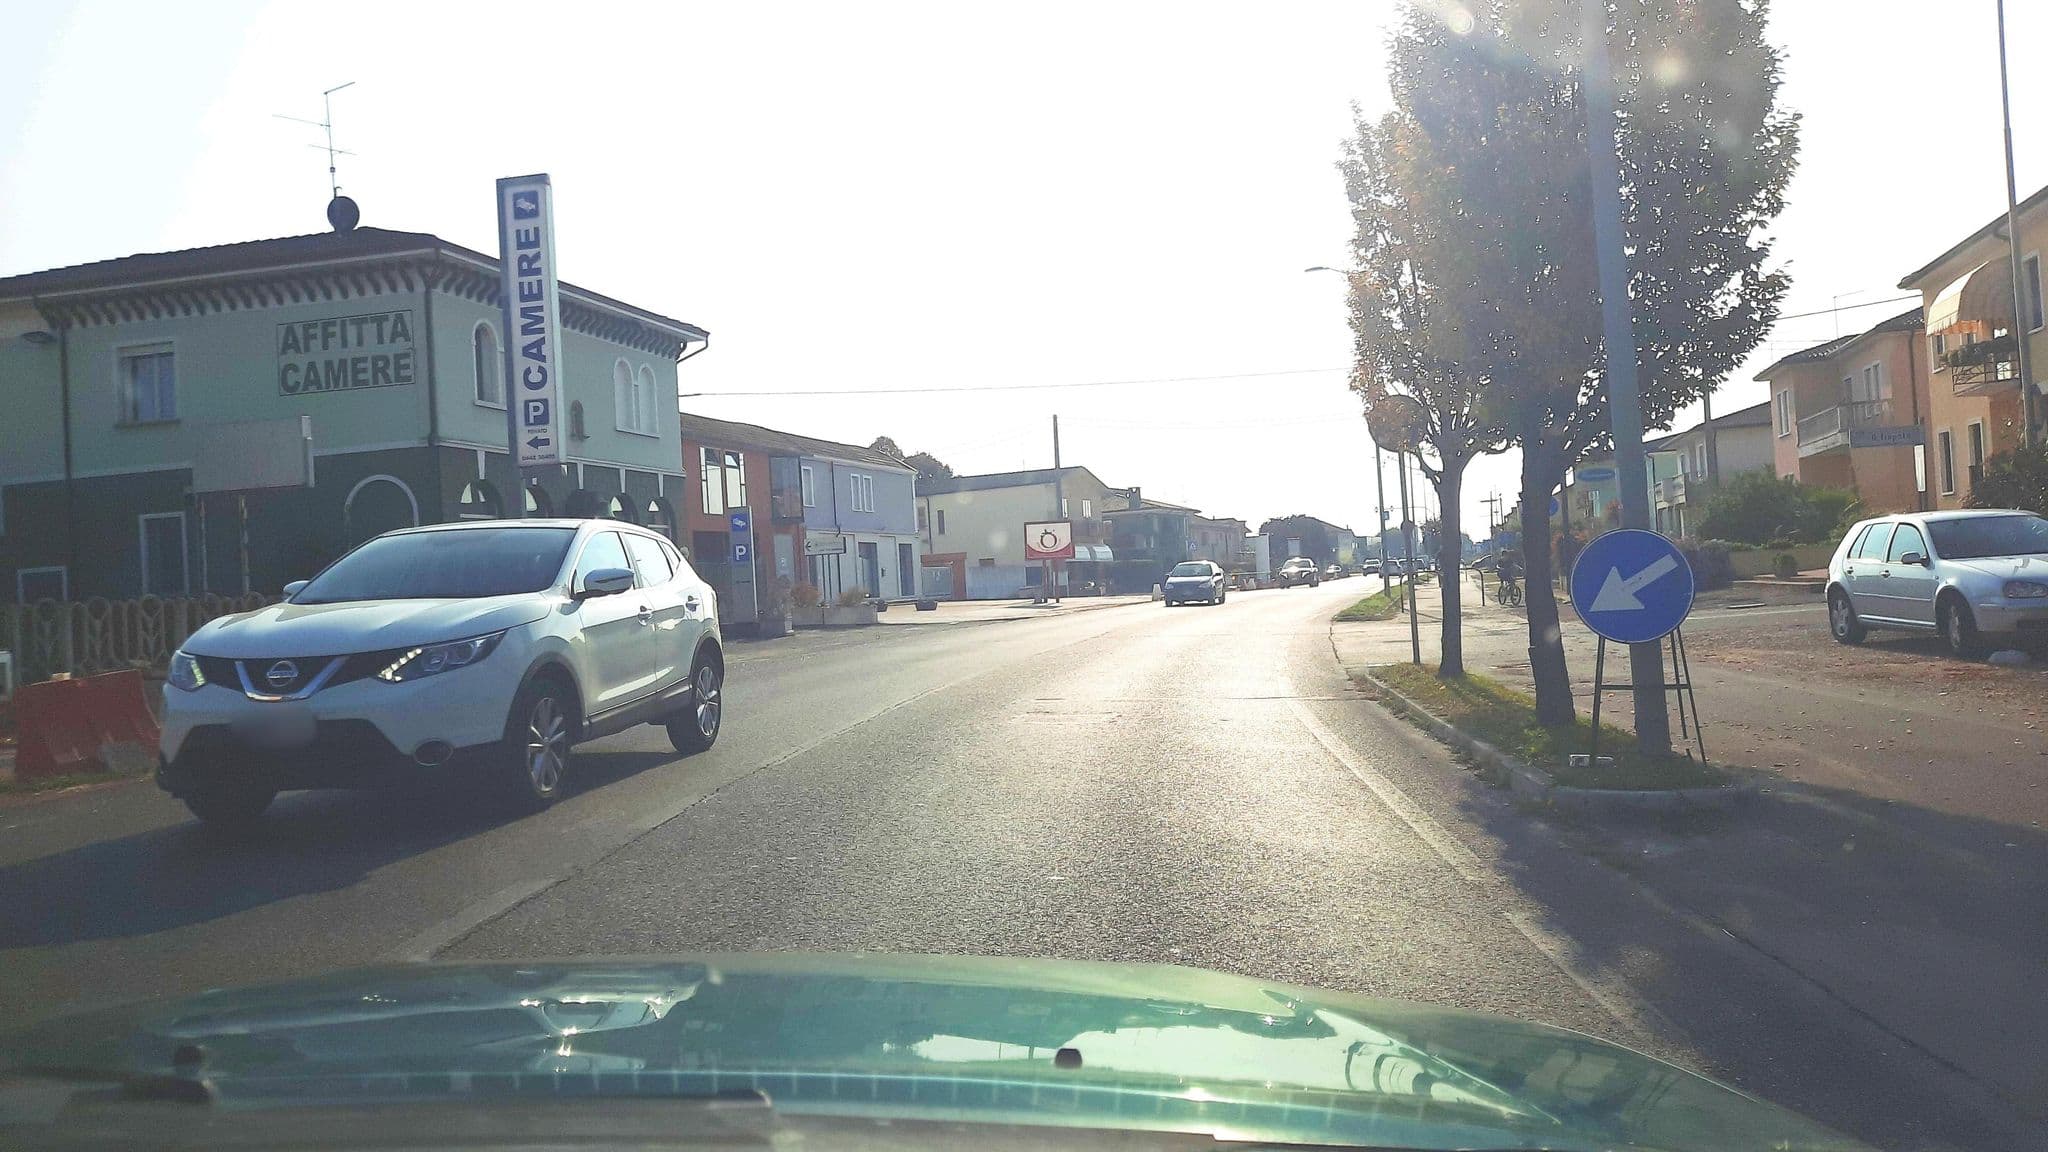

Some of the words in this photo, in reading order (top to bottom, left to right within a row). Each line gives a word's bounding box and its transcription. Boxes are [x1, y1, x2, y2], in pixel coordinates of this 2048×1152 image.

[516, 226, 548, 390] CAMERE
[280, 313, 411, 355] AFFITTA
[280, 352, 413, 393] CAMERE
[529, 401, 544, 424] P
[735, 545, 746, 560] P
